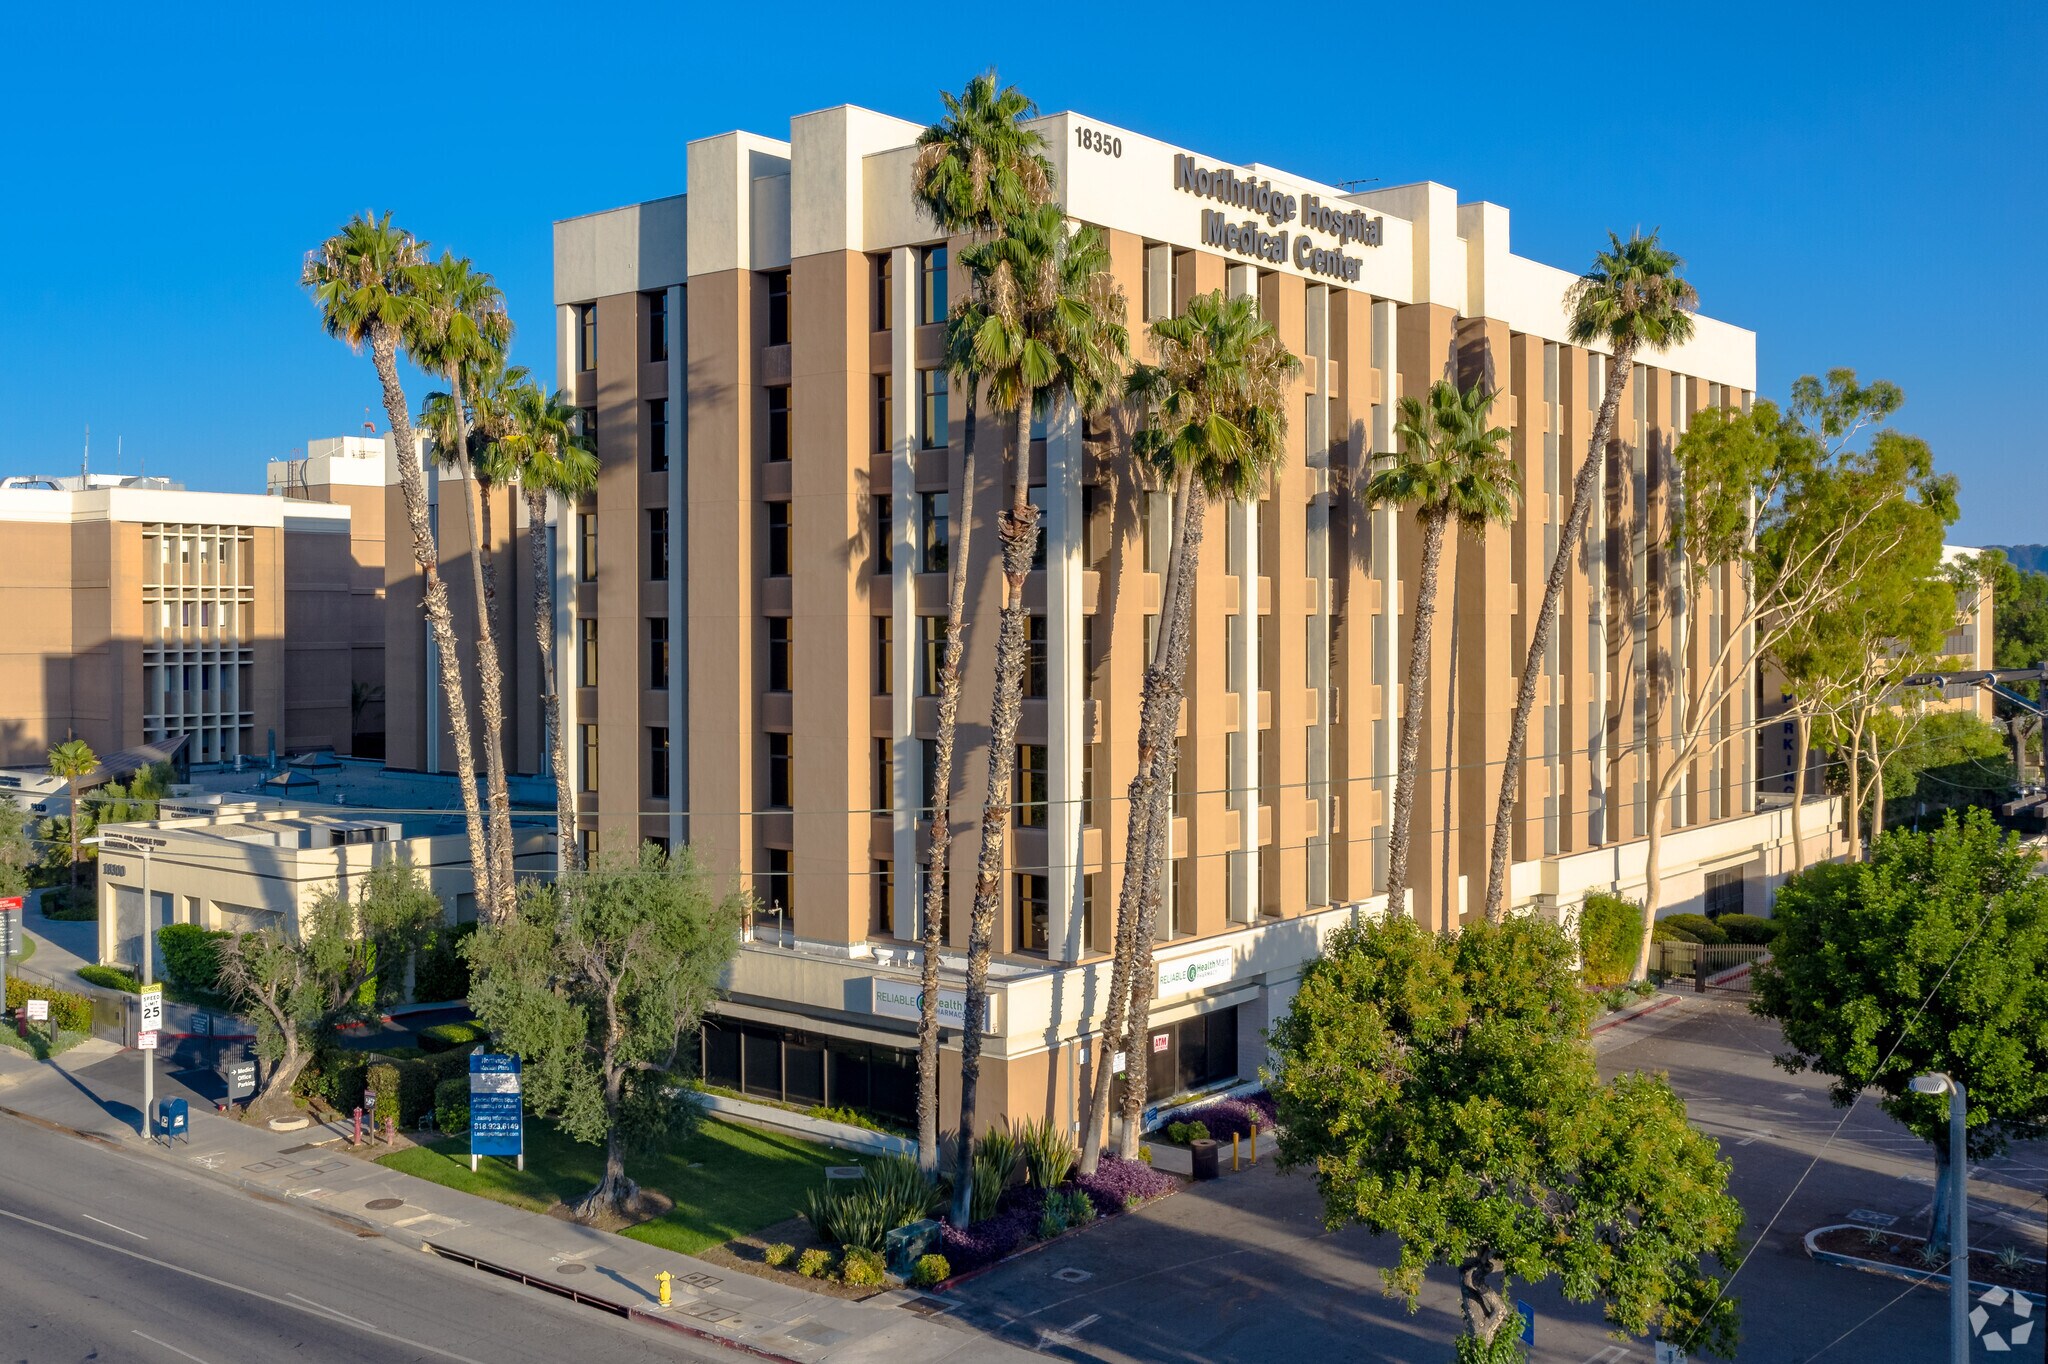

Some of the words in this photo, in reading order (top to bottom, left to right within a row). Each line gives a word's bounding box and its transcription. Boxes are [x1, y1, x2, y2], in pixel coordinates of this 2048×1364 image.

[1075, 126, 1122, 158] 18350
[1174, 153, 1297, 226] Northridge
[1301, 193, 1383, 247] Hospital
[1201, 208, 1288, 263] Medical
[1293, 234, 1363, 283] Center
[1782, 692, 1794, 793] PRKIN
[103, 863, 126, 877] 18300
[1160, 970, 1187, 984] RELIABLE
[1196, 961, 1216, 972] Health
[143, 985, 160, 993] SCHOOL
[876, 991, 915, 1007] RELIABLE
[938, 999, 963, 1011] ealth
[143, 1006, 160, 1019] 25
[936, 1008, 967, 1019] HARMACY
[1155, 1037, 1167, 1047] ATM
